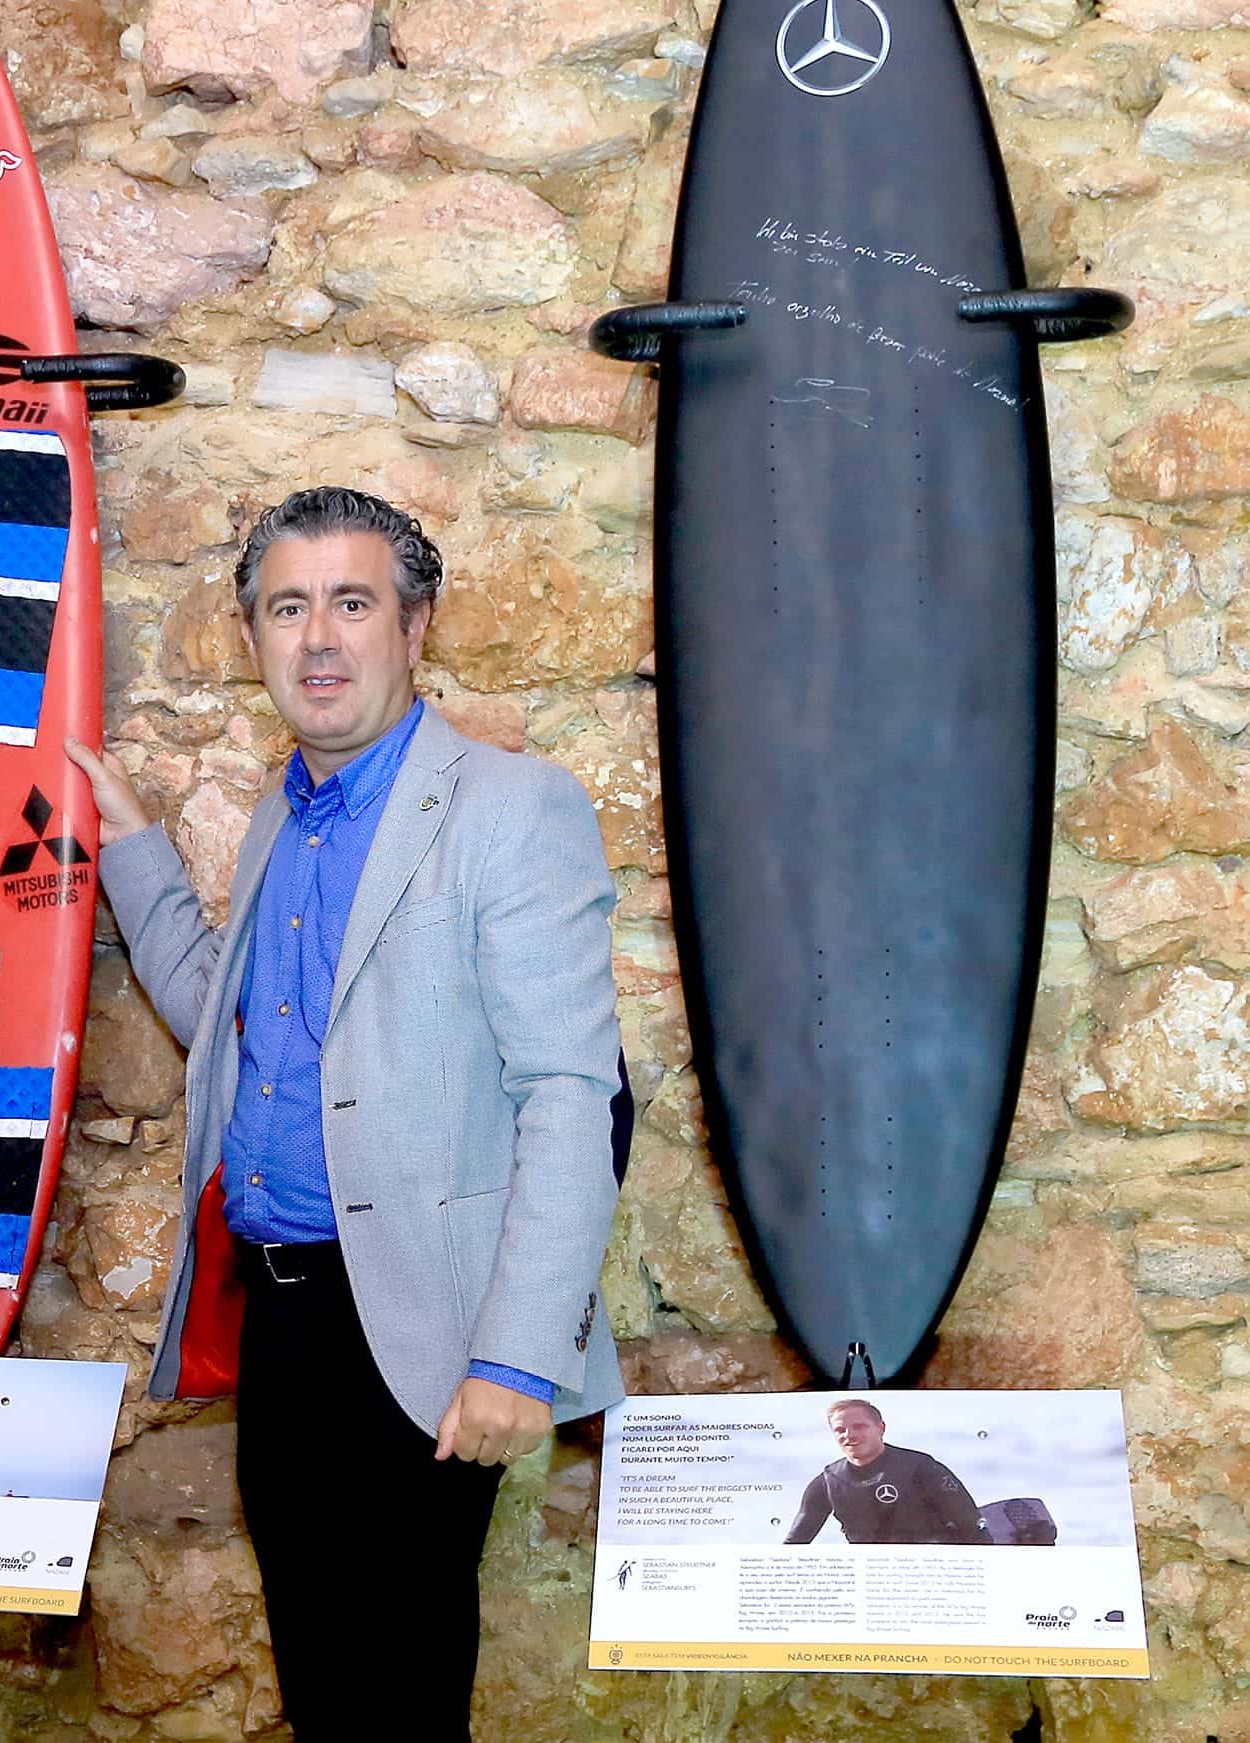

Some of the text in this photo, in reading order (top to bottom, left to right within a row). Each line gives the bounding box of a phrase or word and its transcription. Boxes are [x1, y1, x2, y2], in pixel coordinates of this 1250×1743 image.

[3, 869, 89, 897] MITSUBISHI
[17, 889, 80, 913] MOTORS
[654, 1424, 687, 1432] SURFAR
[621, 1456, 663, 1464] DURANTE
[1, 1562, 28, 1570] norte
[10, 1596, 65, 1607] SURFBOARD
[1025, 1613, 1058, 1621] Praia
[1037, 1620, 1071, 1628] norte
[787, 1653, 928, 1663] NÃO MEXER NA PRANCHA
[944, 1655, 1130, 1667] DO NOT TOUCH THE SURFBOARD
